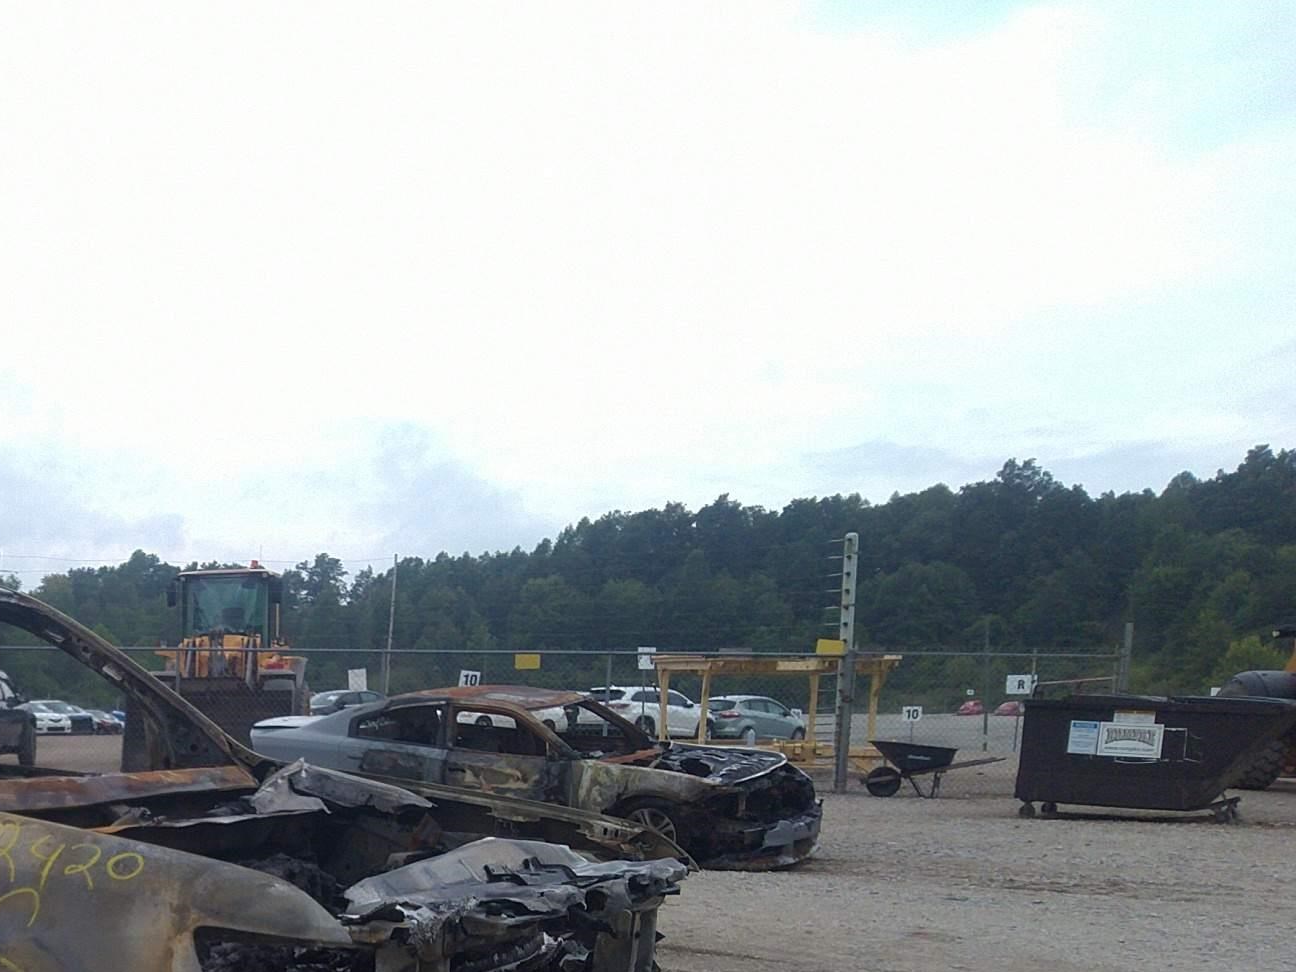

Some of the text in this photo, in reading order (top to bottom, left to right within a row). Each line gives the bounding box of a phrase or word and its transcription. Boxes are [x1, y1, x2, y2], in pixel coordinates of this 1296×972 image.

[463, 674, 478, 686] 10
[1017, 679, 1025, 690] R
[905, 708, 920, 720] 10
